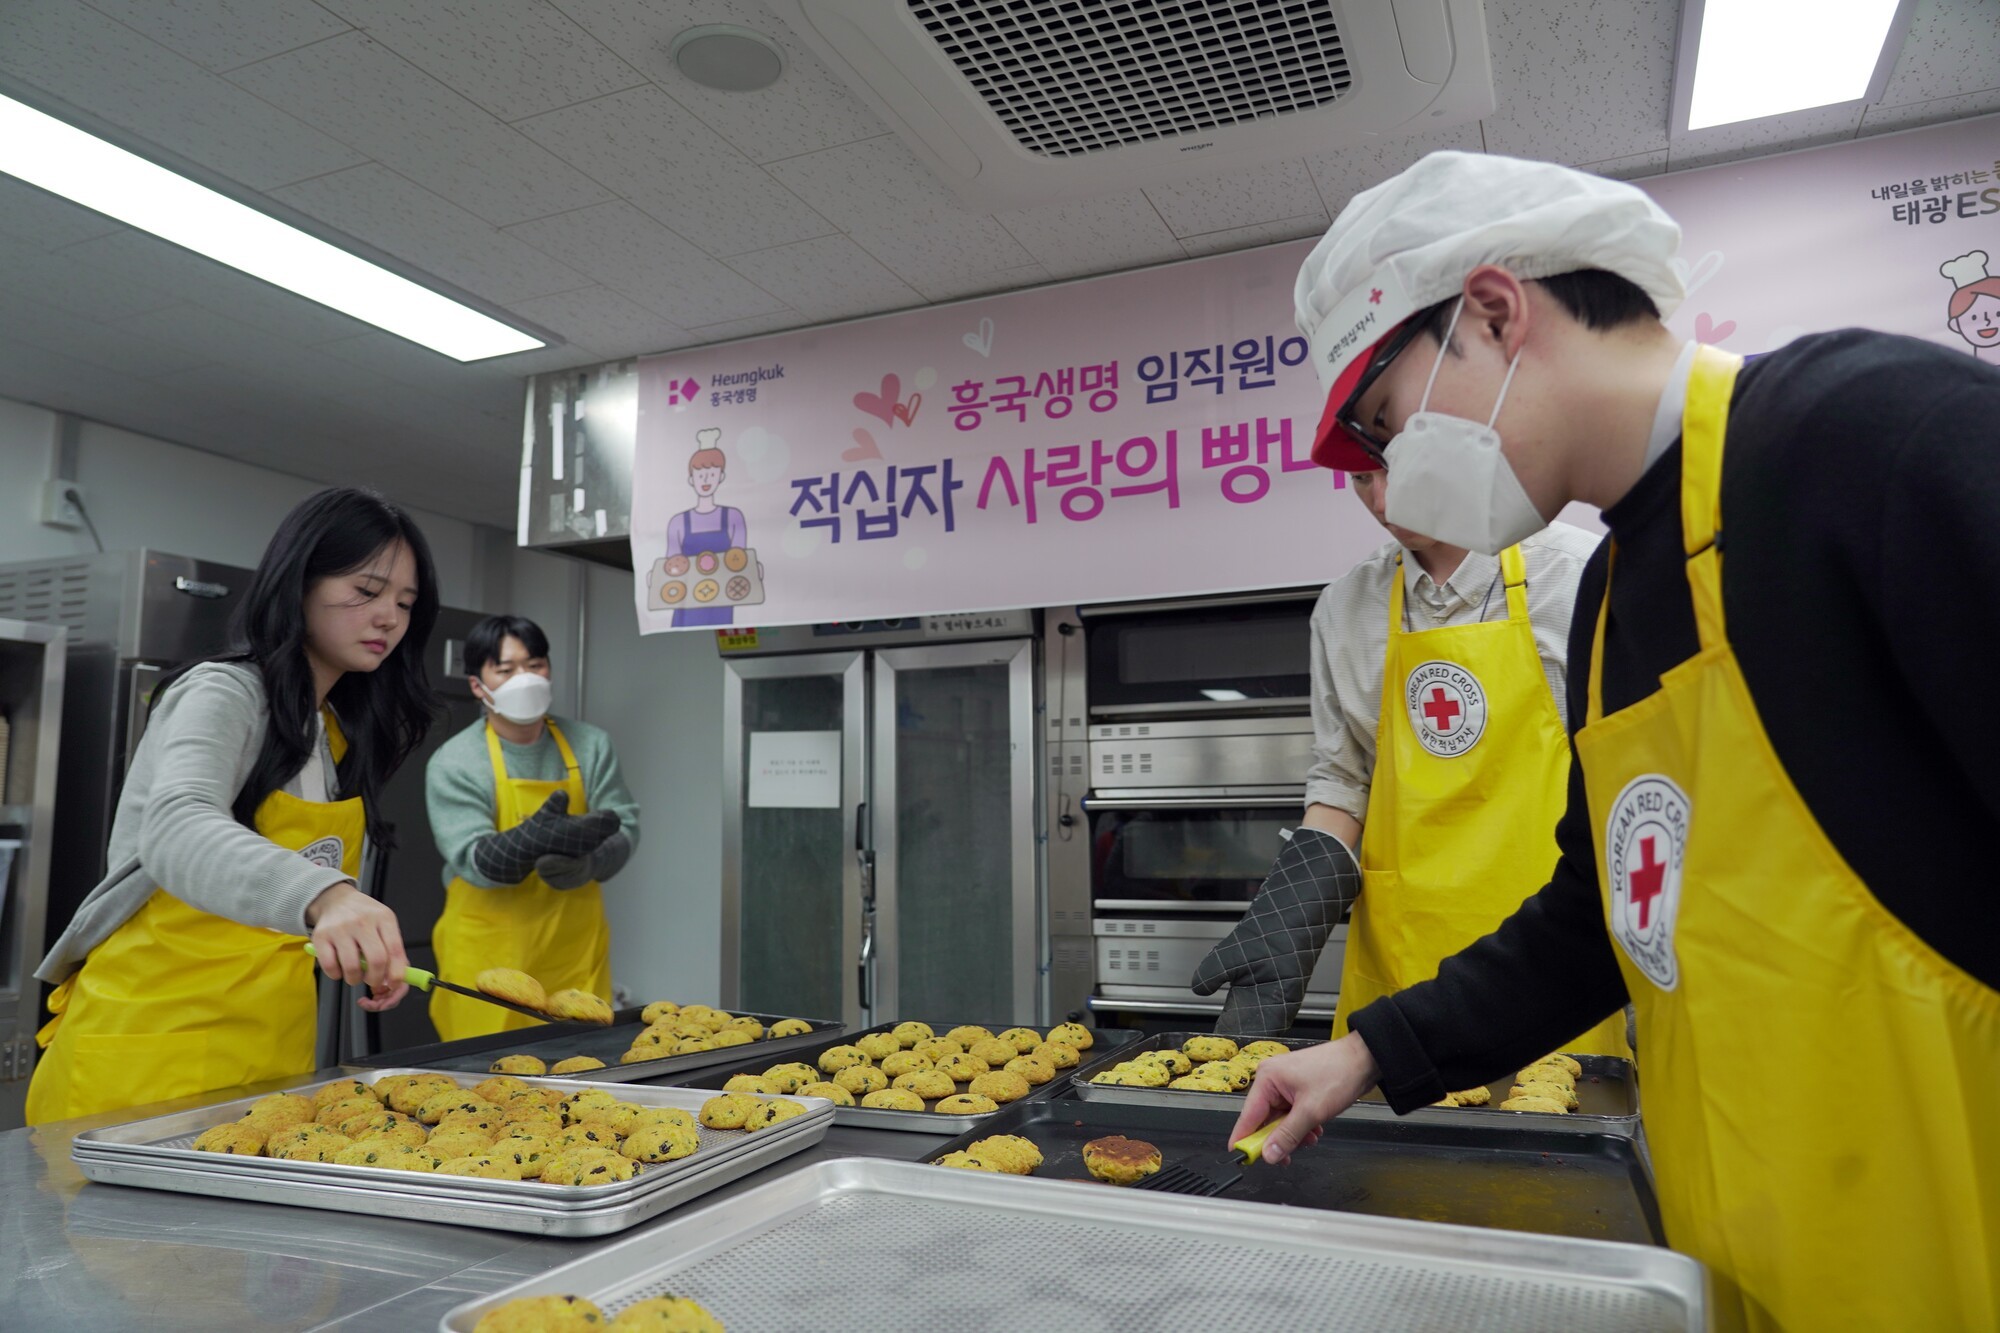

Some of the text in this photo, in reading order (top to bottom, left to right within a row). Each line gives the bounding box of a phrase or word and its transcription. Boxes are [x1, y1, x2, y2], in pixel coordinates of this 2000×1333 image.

[1871, 179, 1928, 201] 내일을
[1930, 170, 1990, 192] 밝히는
[1892, 194, 1952, 226] 태광
[711, 363, 785, 387] Heungkuk
[711, 387, 757, 407] 흥국생명
[947, 360, 1119, 431] 흥국생명
[789, 458, 963, 543] 적십자
[976, 429, 1180, 524] 사랑의
[1408, 667, 1479, 710] KOREAN RED CROSS
[1421, 727, 1475, 751] 대한적십자사
[1613, 801, 1636, 892] KOREAN
[1637, 792, 1664, 815] RED
